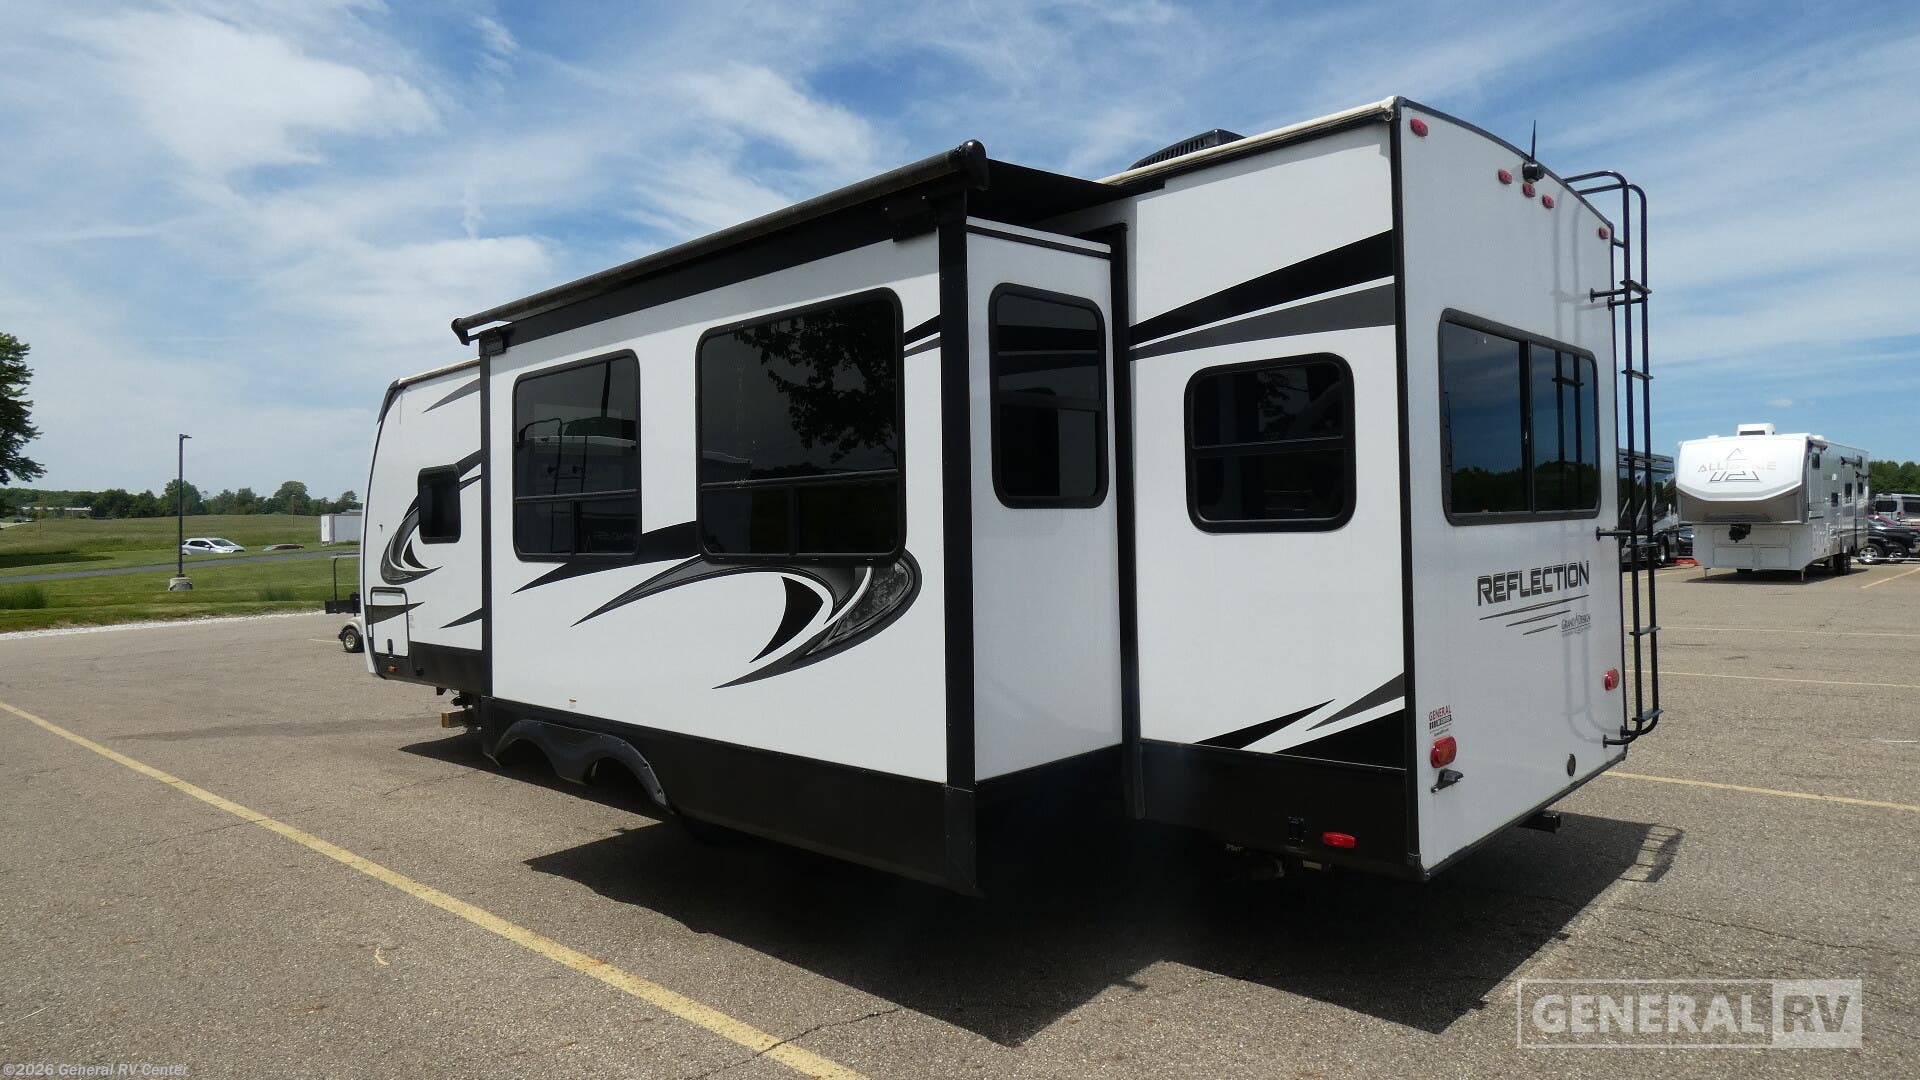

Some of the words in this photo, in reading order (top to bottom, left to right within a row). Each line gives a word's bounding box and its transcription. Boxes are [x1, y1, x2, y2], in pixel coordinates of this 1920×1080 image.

[1697, 461, 1777, 473] ALLIE
[1477, 560, 1590, 606] REFLECTION
[1428, 704, 1452, 721] GENERAL
